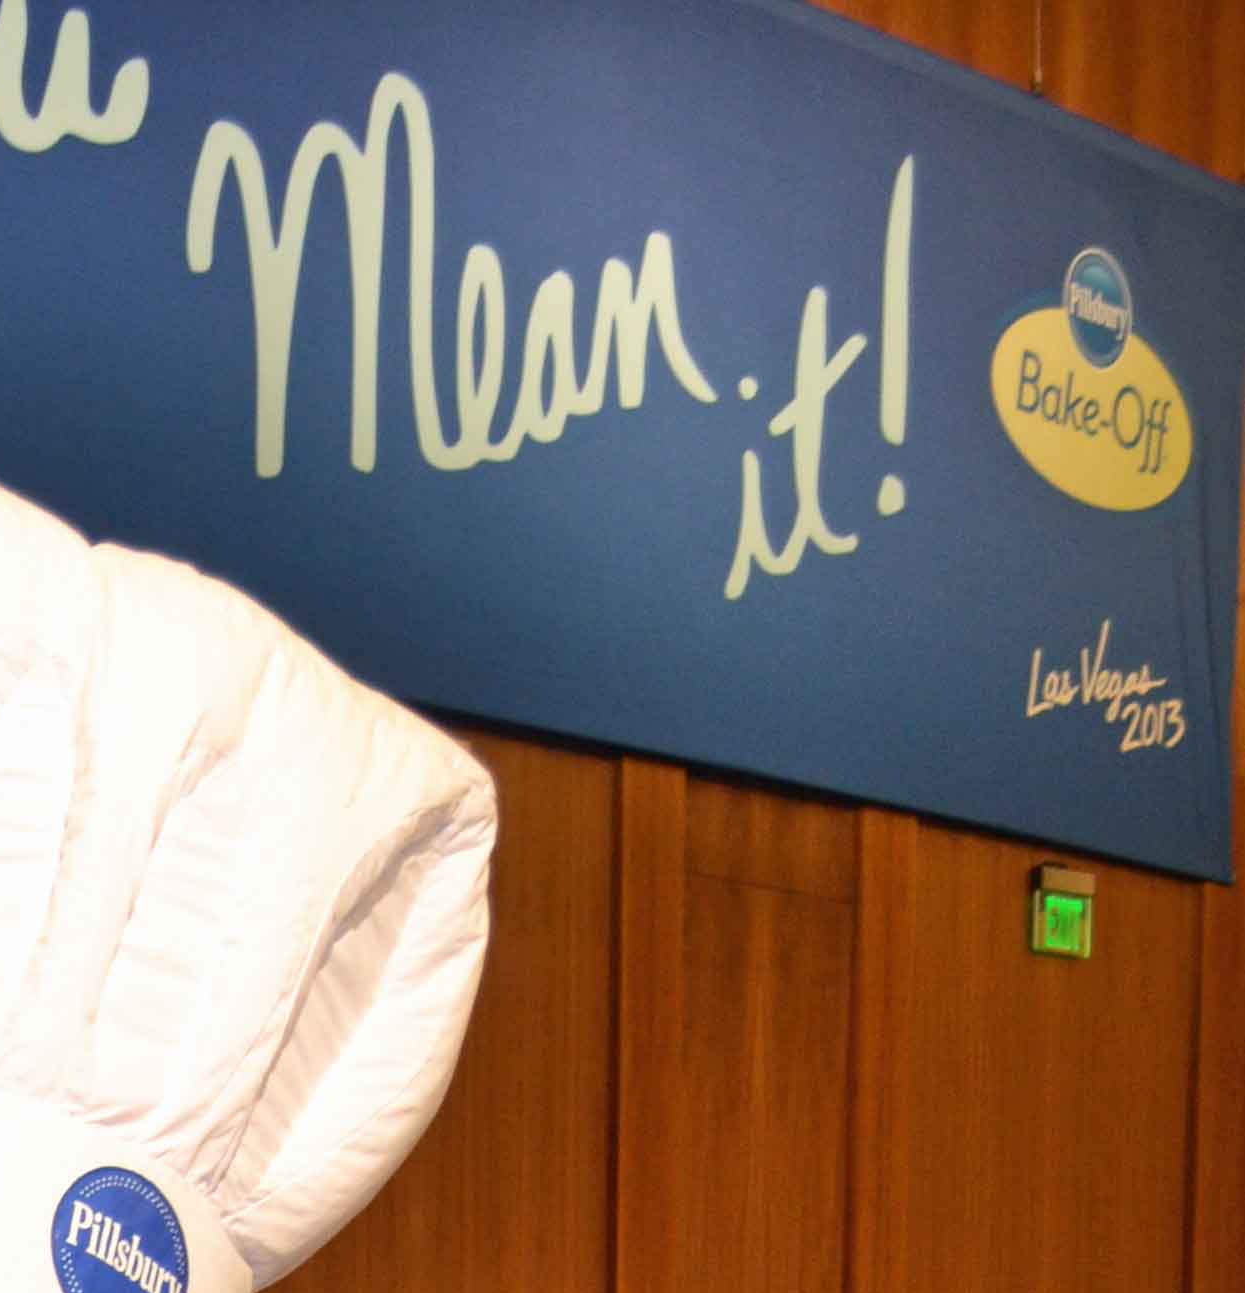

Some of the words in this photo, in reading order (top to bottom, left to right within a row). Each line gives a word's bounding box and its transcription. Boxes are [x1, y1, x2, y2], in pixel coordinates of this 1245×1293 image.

[186, 74, 717, 477] Mean
[724, 153, 914, 600] it!
[1016, 349, 1172, 475] Bake-Off
[1026, 648, 1079, 718] Las
[1080, 618, 1168, 723] Vegas
[1120, 698, 1187, 752] 2013
